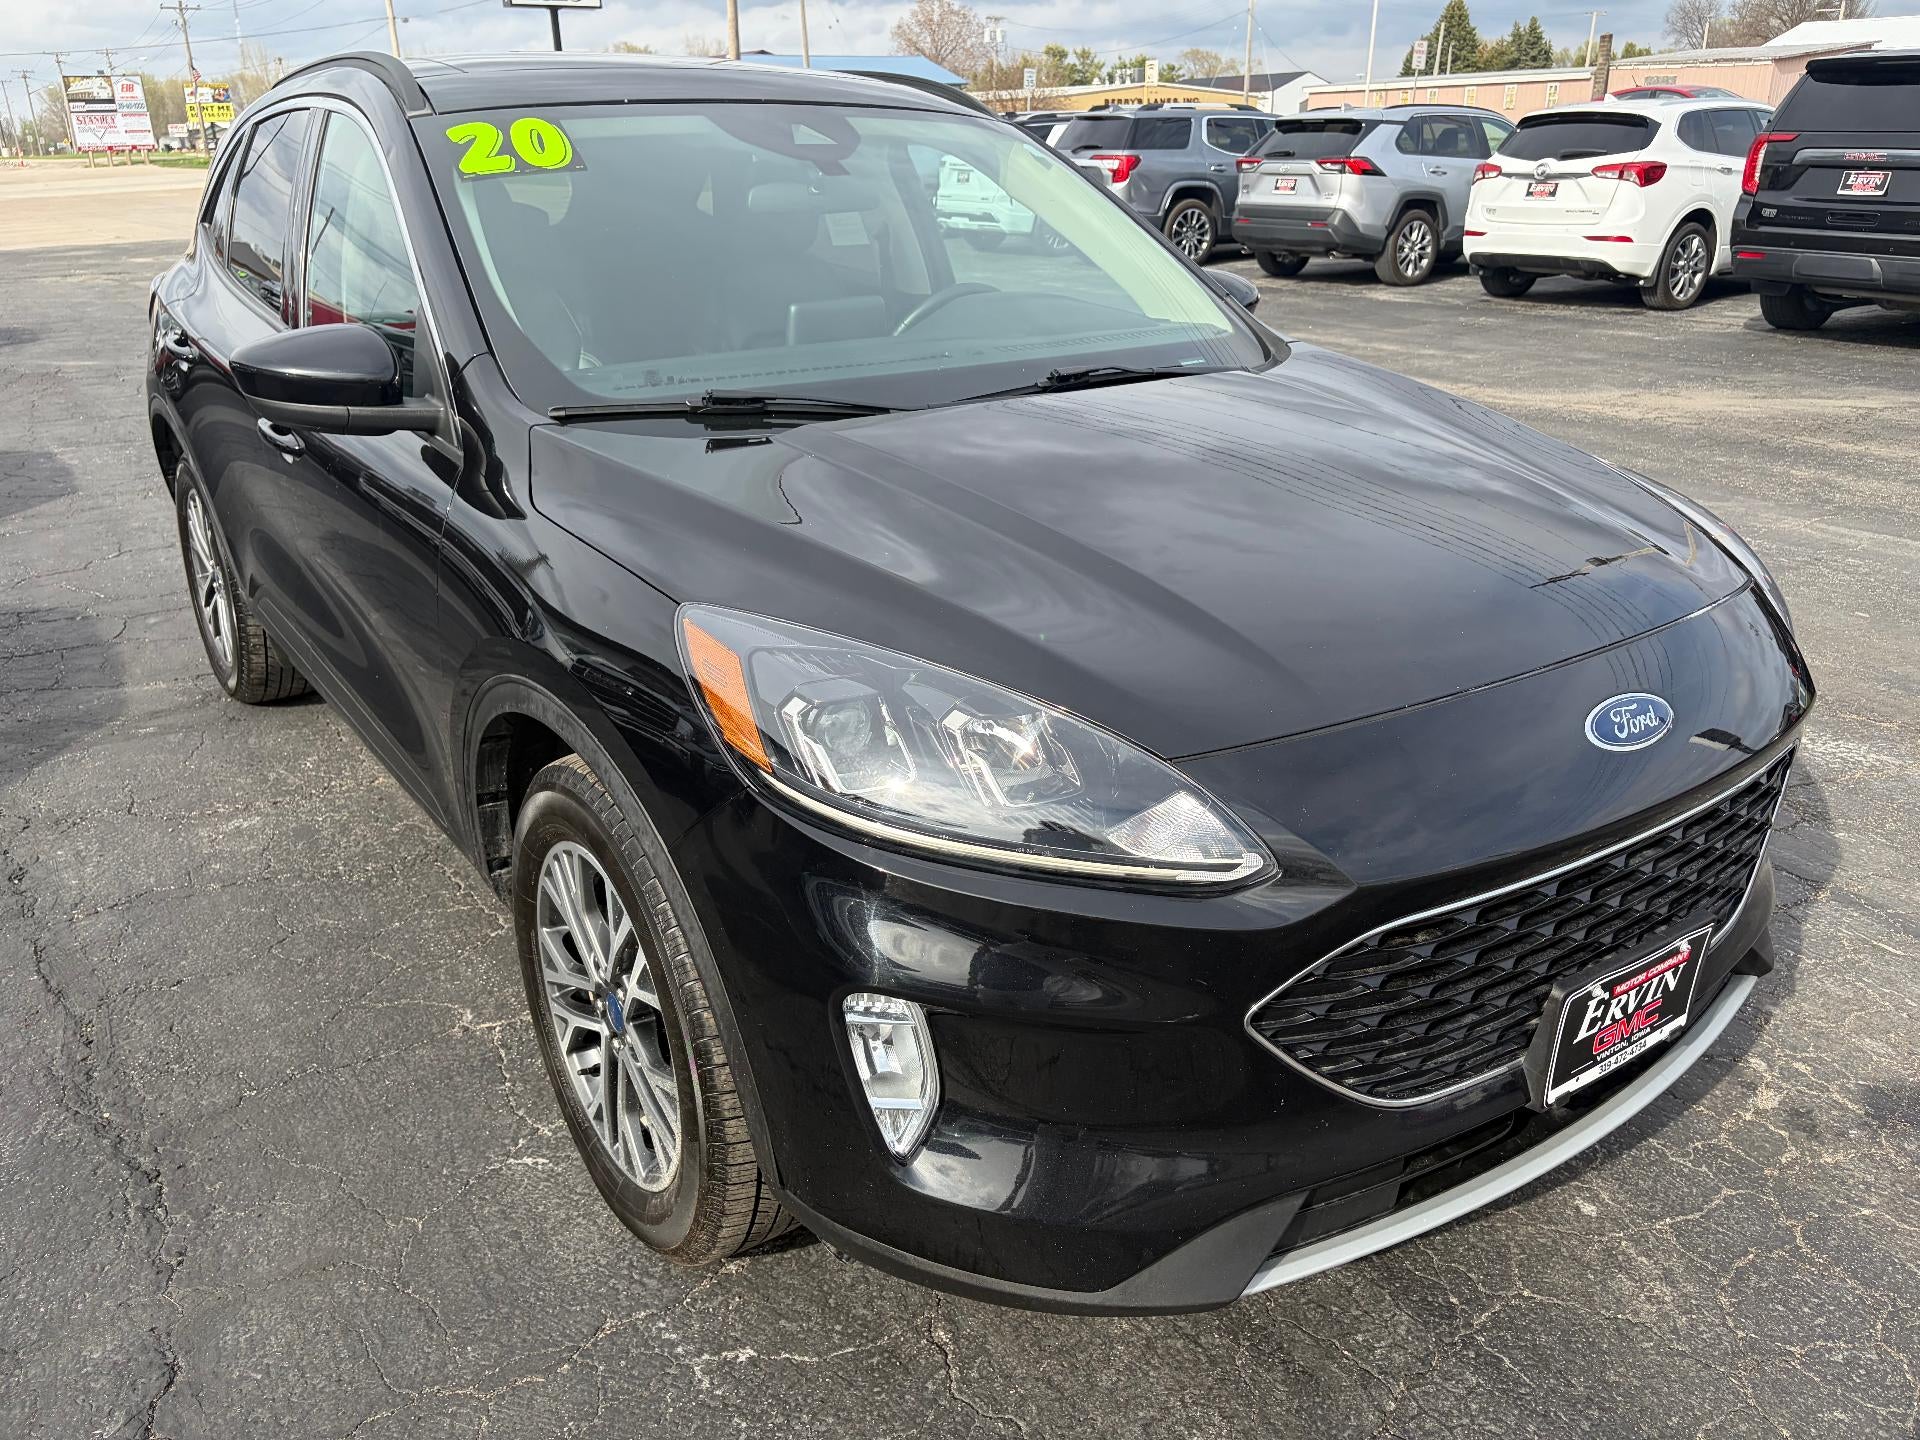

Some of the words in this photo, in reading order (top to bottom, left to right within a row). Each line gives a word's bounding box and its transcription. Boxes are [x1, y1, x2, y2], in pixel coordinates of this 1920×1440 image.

[445, 117, 573, 175] 20
[1846, 174, 1884, 185] ERVIN
[1609, 702, 1660, 739] Ford
[1614, 971, 1647, 995] MOTOR
[1647, 951, 1690, 977] COMPANY
[1572, 961, 1688, 1044] ERVIN
[1593, 998, 1663, 1055] GMC
[1631, 1026, 1651, 1043] IOWA
